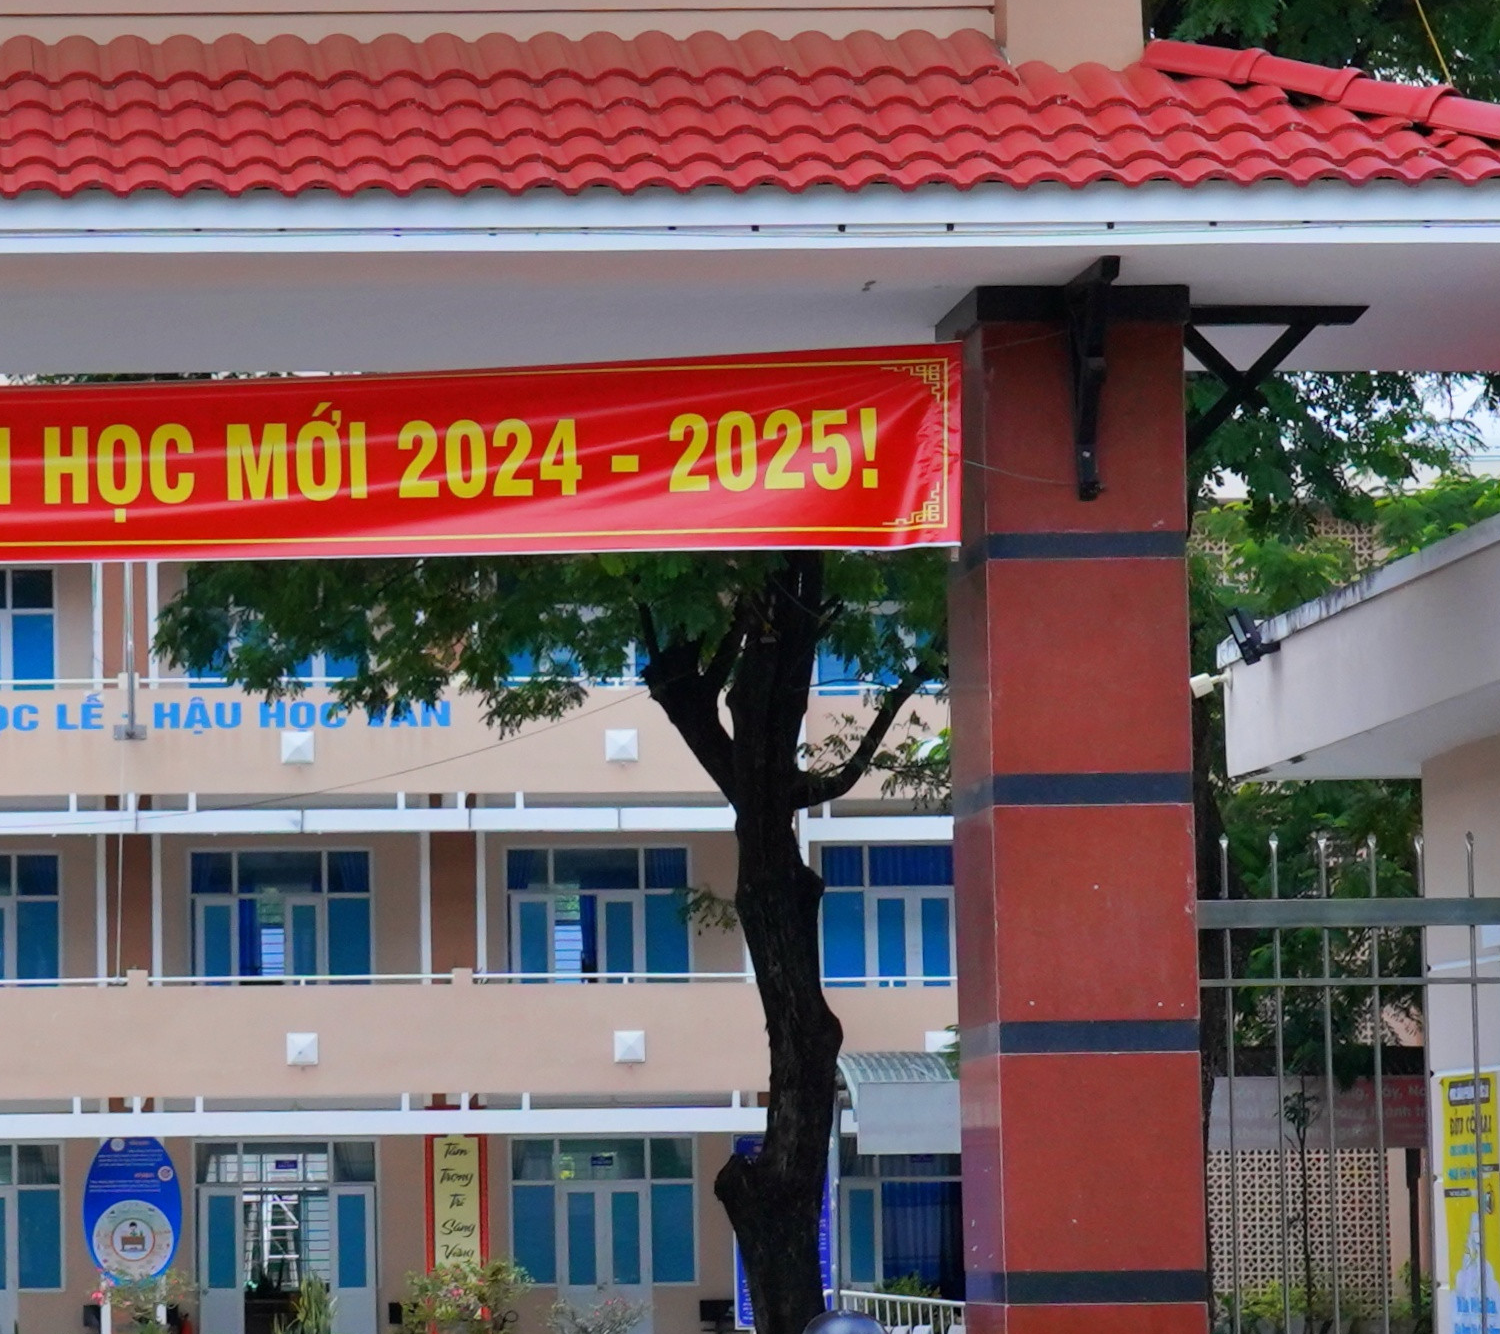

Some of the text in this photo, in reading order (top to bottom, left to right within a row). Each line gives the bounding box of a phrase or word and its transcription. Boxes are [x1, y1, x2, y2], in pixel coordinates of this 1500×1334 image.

[42, 423, 196, 524] HỌC
[226, 403, 369, 503] MỚI
[396, 417, 584, 499] 2024
[609, 453, 640, 475] -
[667, 408, 881, 494] 2025!
[56, 690, 105, 731] LỄ
[153, 695, 242, 735] HẬU
